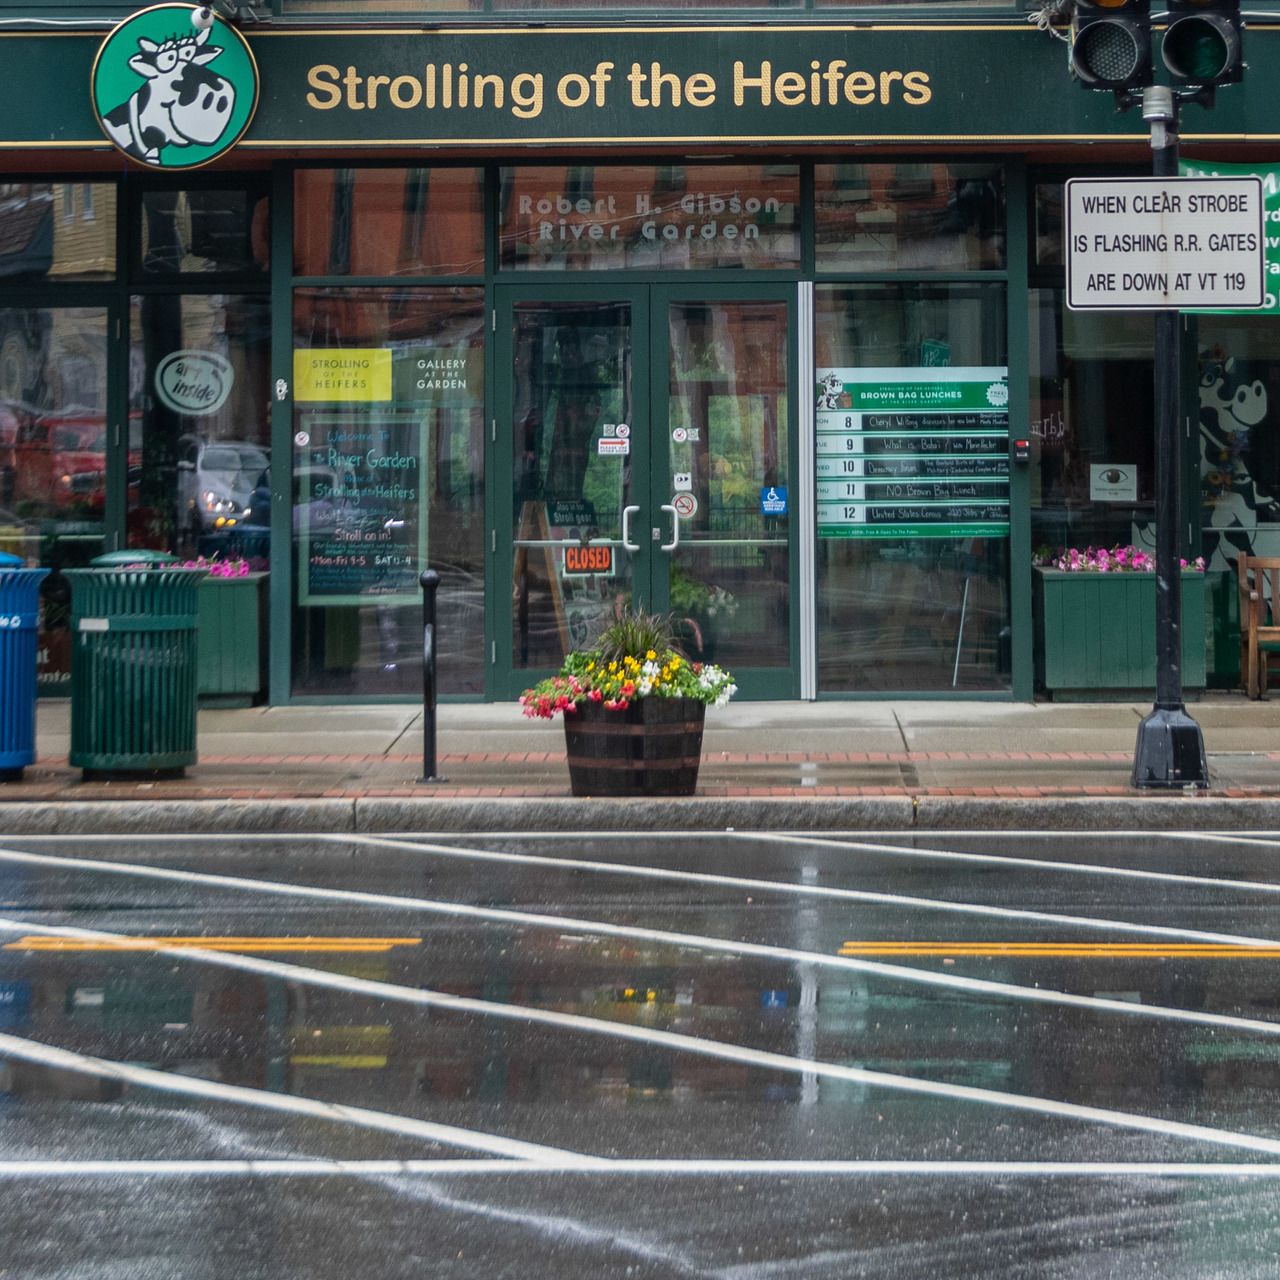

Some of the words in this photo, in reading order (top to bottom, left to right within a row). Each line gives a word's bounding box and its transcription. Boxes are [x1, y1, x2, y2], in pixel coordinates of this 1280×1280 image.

[306, 62, 544, 119] Strolling
[557, 61, 615, 108] of
[628, 61, 717, 108] the
[733, 59, 933, 106] Heifers
[519, 195, 617, 215] Robert
[636, 194, 663, 215] H.
[680, 192, 780, 215] Gibson
[1082, 196, 1127, 214] WHEN
[1132, 195, 1182, 213] CLEAR
[1187, 194, 1248, 213] STROBE
[540, 219, 620, 240] River
[641, 220, 760, 240] Garden
[1074, 234, 1088, 252] IS
[1094, 234, 1168, 252] FLASHING
[1174, 234, 1202, 252] R.R.
[1208, 233, 1257, 251] GATES
[1086, 273, 1116, 291] ARE
[1122, 273, 1168, 291] DOWN
[1174, 273, 1192, 291] AT
[1198, 273, 1218, 290] VT
[1223, 272, 1246, 290] 119
[311, 359, 370, 369] STROLLING
[417, 359, 467, 369] GALLERY
[172, 380, 215, 402] inside
[315, 380, 368, 390] HEIFERS
[416, 379, 467, 390] GARDEN
[860, 392, 895, 400] BROWN
[898, 392, 918, 400] BAG
[920, 391, 963, 399] LUNCHES
[845, 416, 852, 429] 8
[846, 438, 854, 451] 9
[883, 439, 902, 449] What
[328, 447, 362, 468] River
[366, 448, 417, 469] Garden
[843, 460, 855, 473] 10
[315, 483, 360, 505] Strolling
[376, 483, 415, 500] Heifers
[846, 483, 856, 496] 11
[886, 484, 902, 497] NO
[907, 485, 932, 496] Brown
[953, 485, 977, 496] Lunch
[844, 507, 856, 519] 12
[871, 508, 896, 519] United
[335, 528, 361, 541] Stroll
[375, 555, 393, 566] SAT
[566, 546, 611, 570] CLOSED
